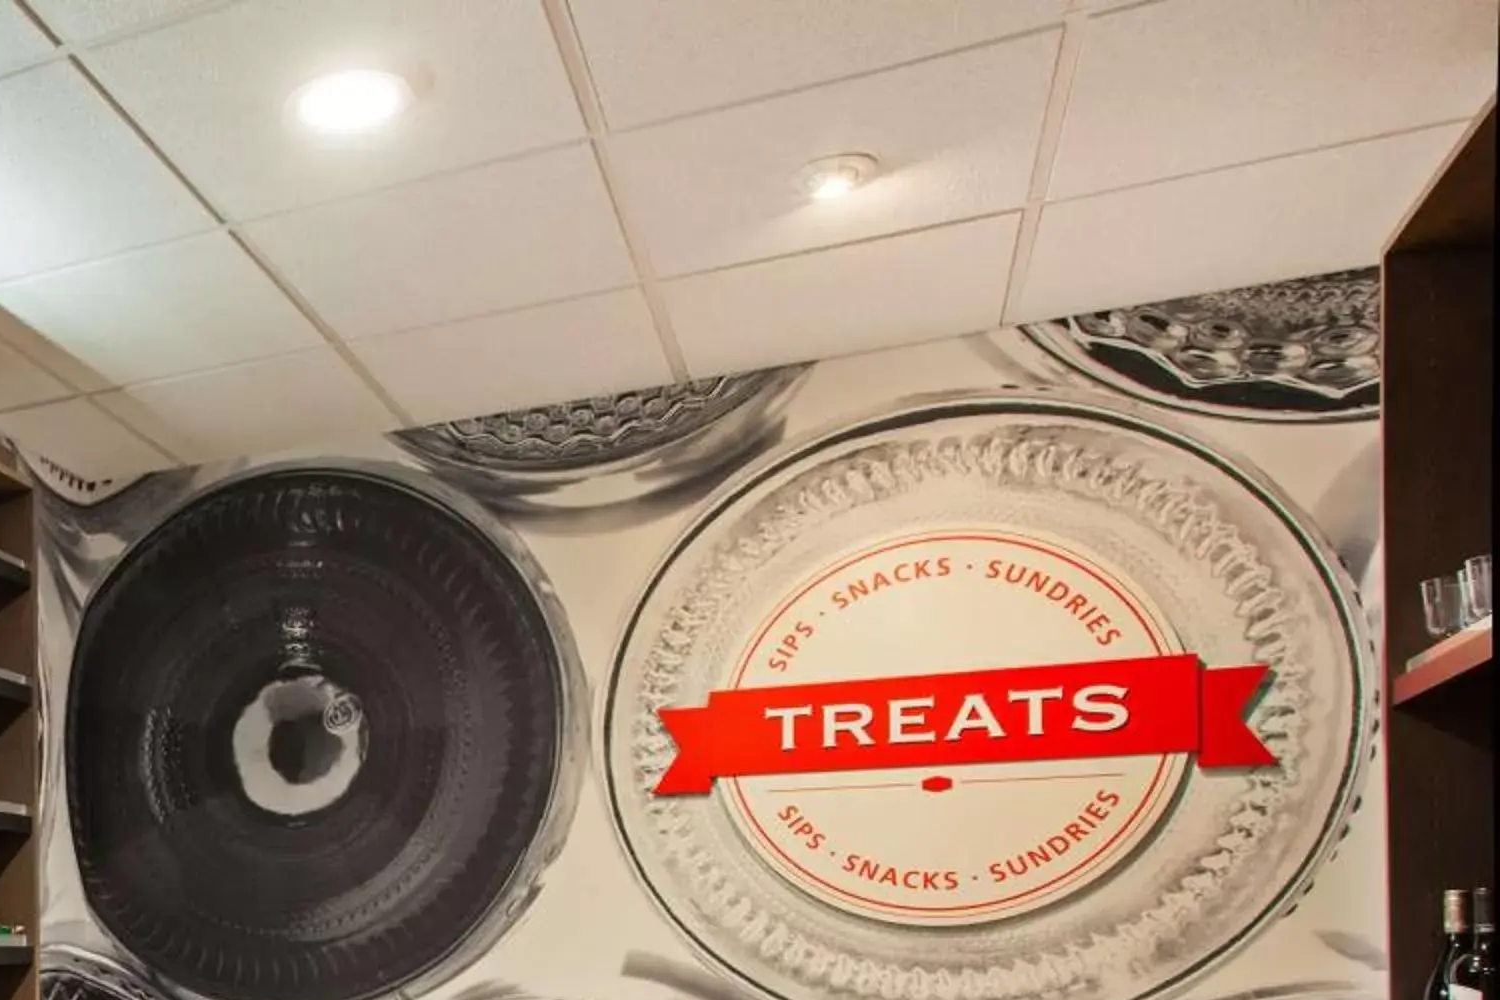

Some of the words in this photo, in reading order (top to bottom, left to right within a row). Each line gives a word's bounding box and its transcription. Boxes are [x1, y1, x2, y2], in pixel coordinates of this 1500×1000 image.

[768, 620, 815, 672] SIPS
[831, 557, 951, 610] SNACKS
[985, 559, 1124, 648] SUNDRIES
[763, 683, 1132, 752] TREATS
[776, 804, 826, 851] SIPS
[841, 853, 959, 890] SNACKS
[988, 788, 1121, 884] SUNDRIES
